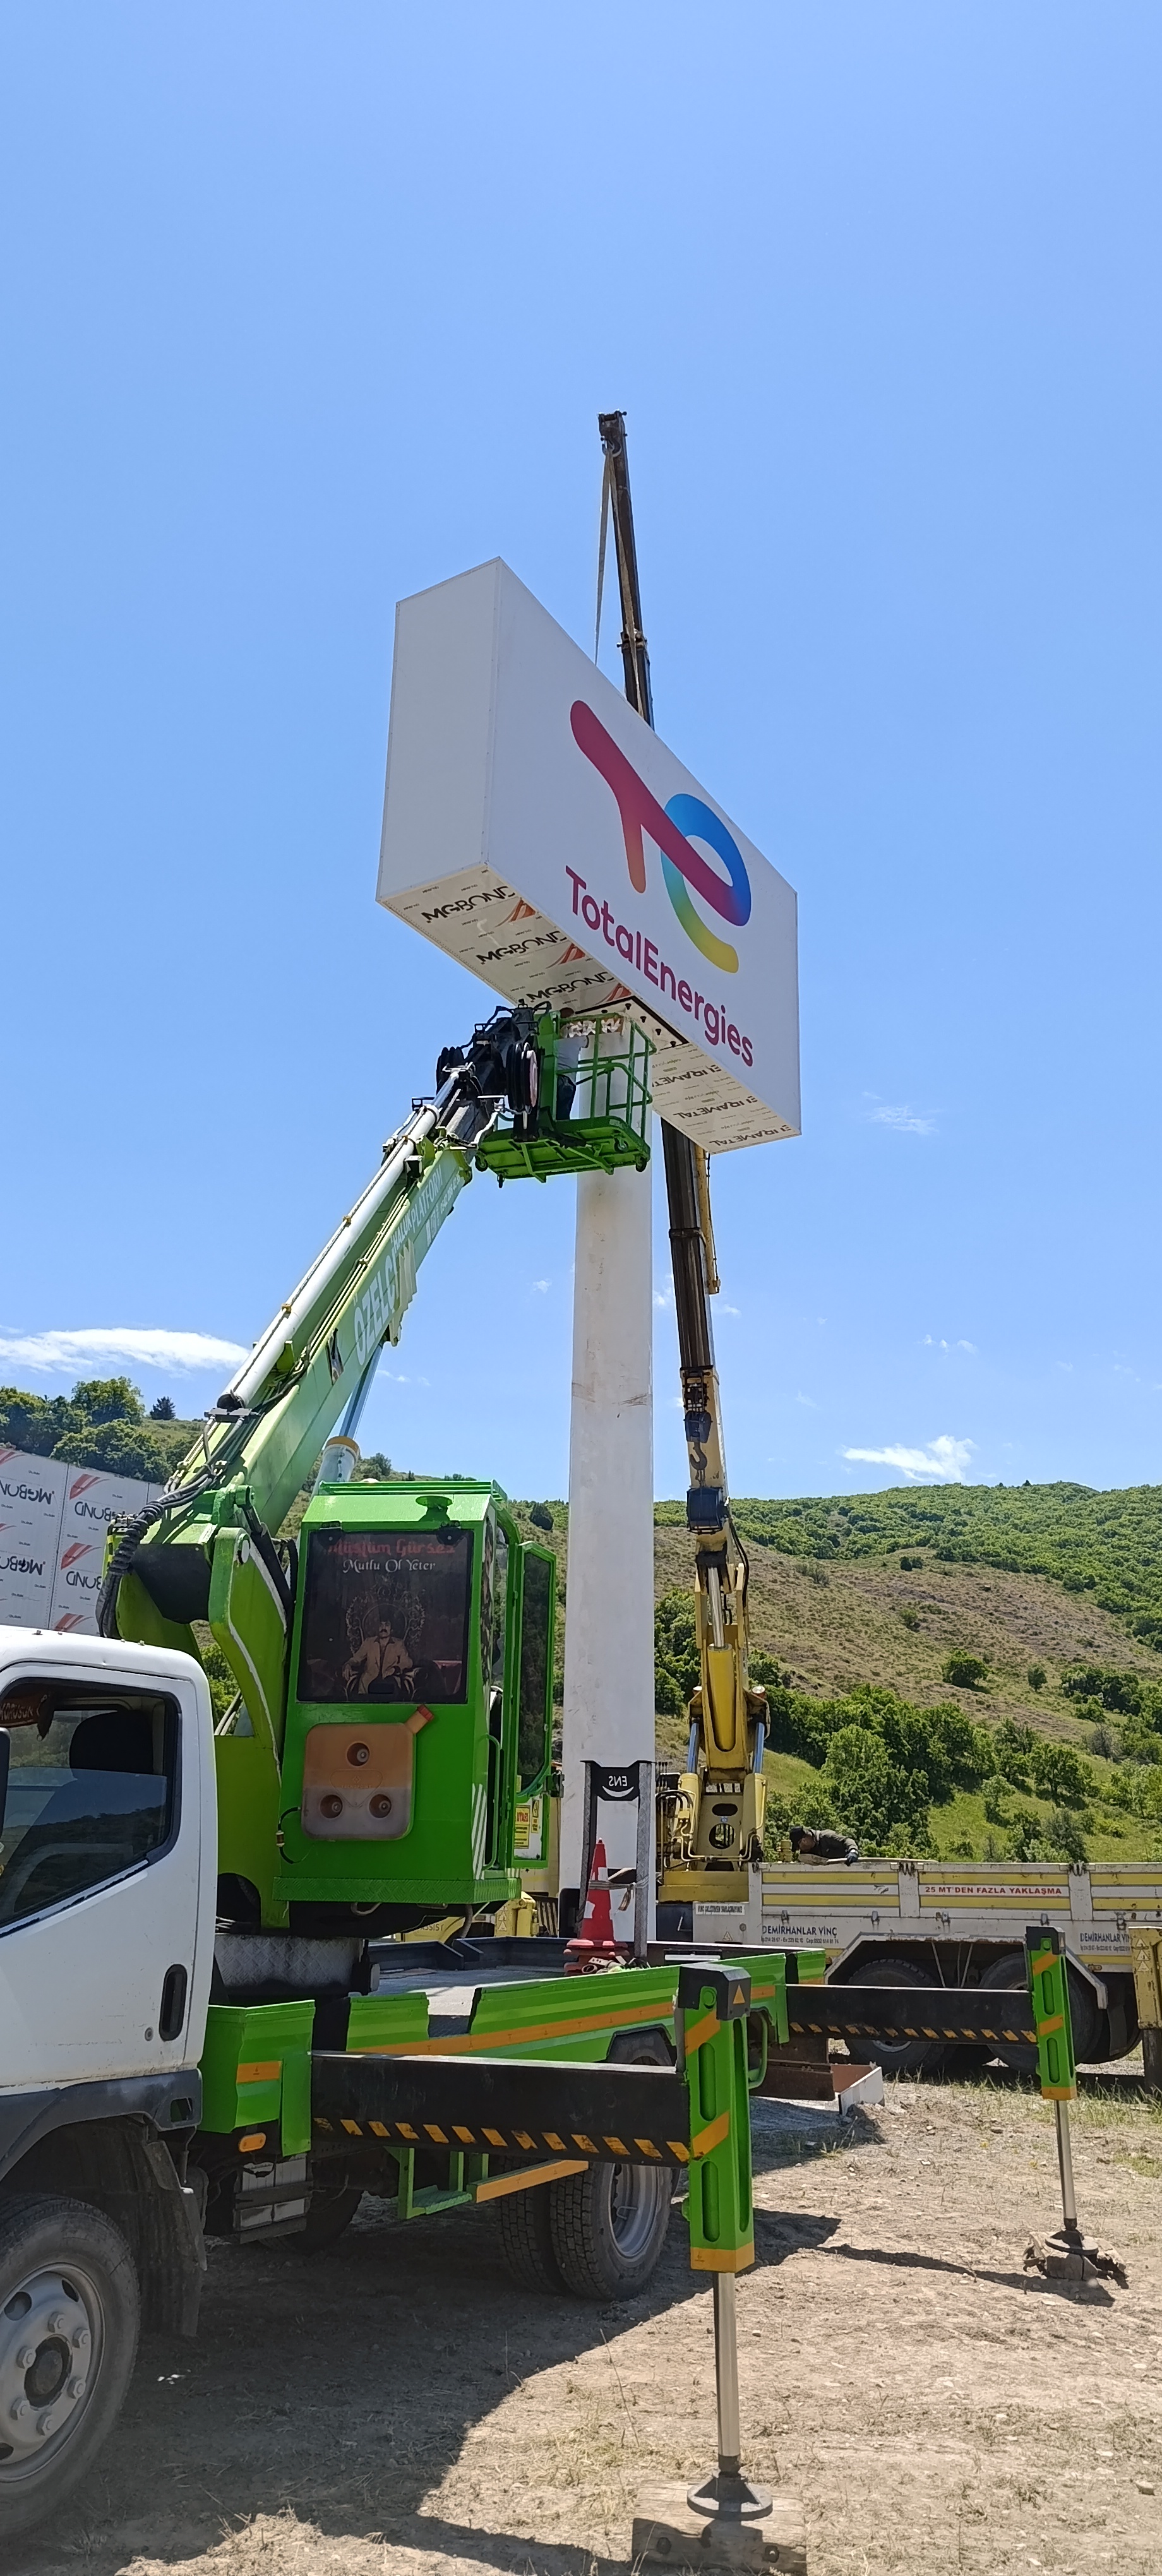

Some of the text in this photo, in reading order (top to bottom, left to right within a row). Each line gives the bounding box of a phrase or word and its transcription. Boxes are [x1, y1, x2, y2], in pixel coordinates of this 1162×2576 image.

[421, 886, 517, 923] MGBOND
[476, 931, 567, 965] MGBOND
[565, 865, 753, 1068] TotalEnergies
[526, 971, 614, 1003] MGBOND
[652, 1064, 722, 1088] EURAMET
[673, 1095, 758, 1119] EURAMETAL
[709, 1124, 791, 1147] EURAMETAL
[410, 1164, 443, 1234] PLATFORM
[0, 1479, 54, 1505] MGBON
[0, 1556, 45, 1576] MGBO
[342, 1559, 436, 1573] Mutlu Ol Yeter
[66, 1571, 102, 1590] BOND
[762, 1924, 837, 1938] DEMİRHANLAR VİNÇ
[1080, 1931, 1121, 1943] DEMİRHANLAR
